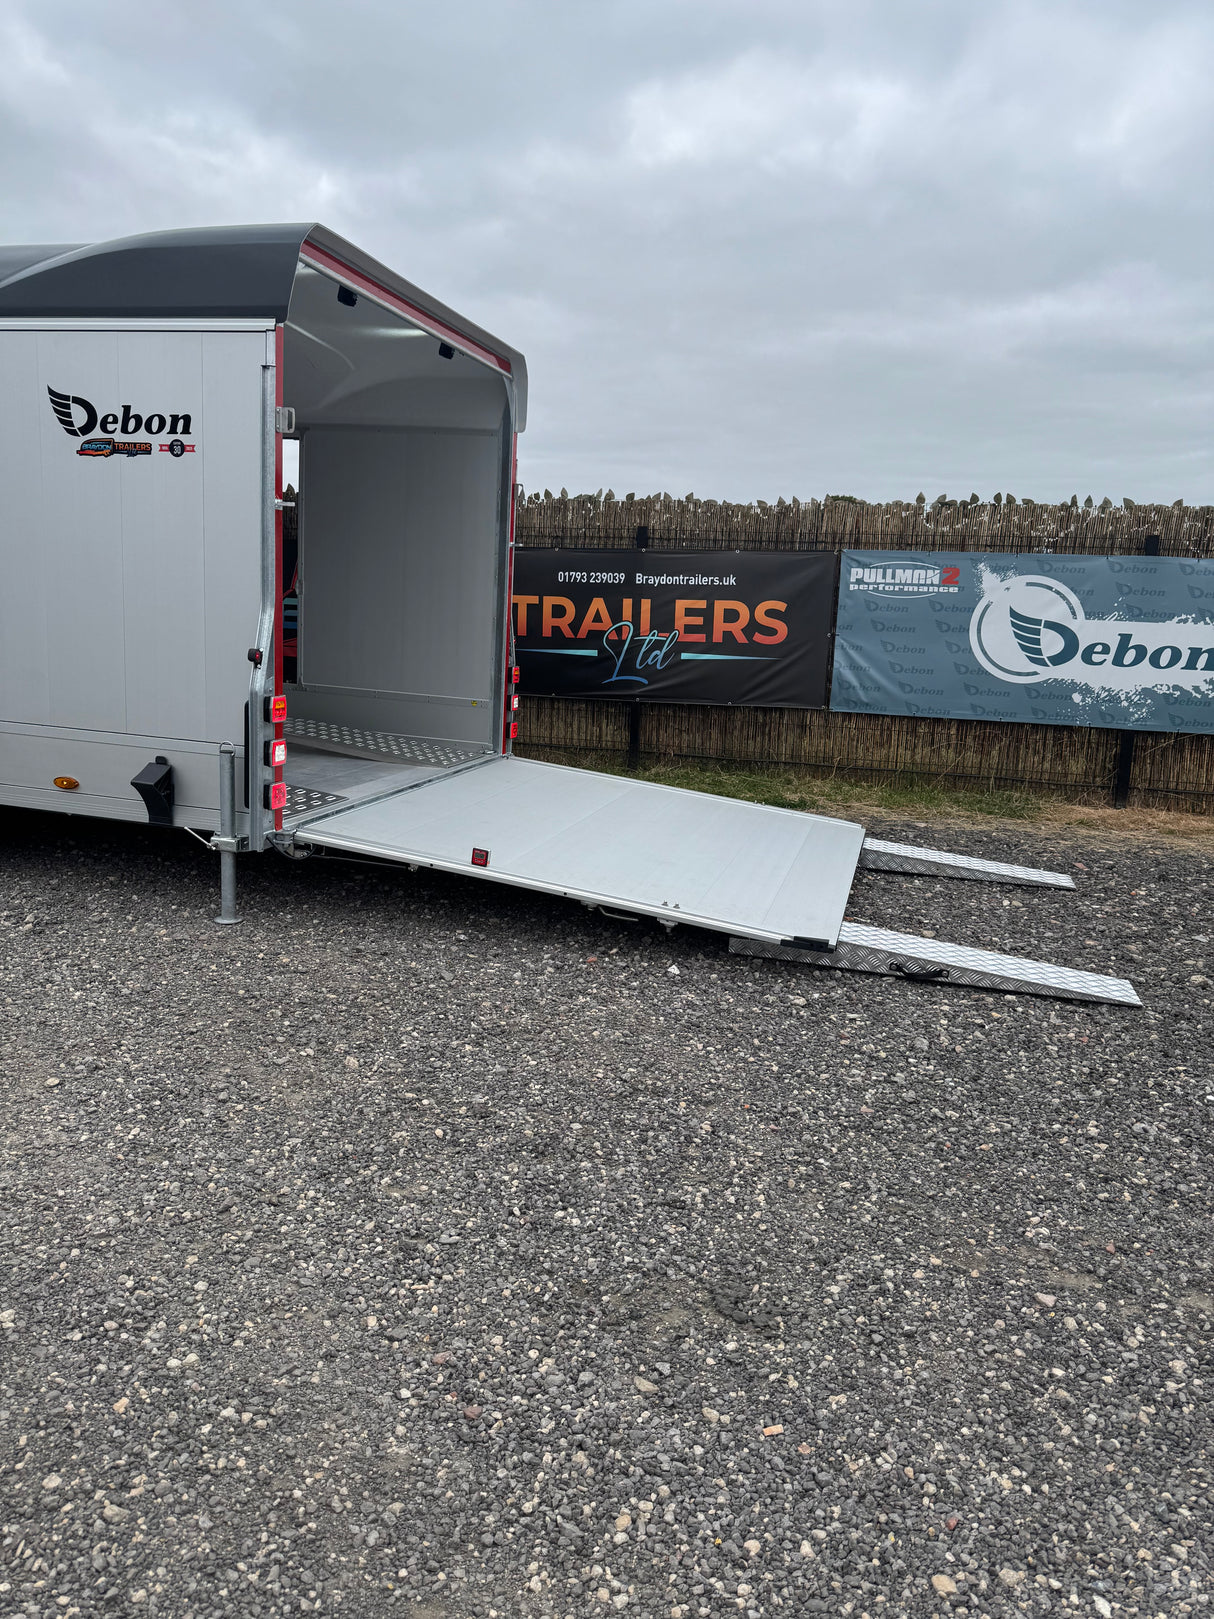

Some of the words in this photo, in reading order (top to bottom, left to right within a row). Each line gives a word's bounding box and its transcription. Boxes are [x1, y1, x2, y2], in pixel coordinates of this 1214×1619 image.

[47, 384, 192, 437] Debon
[114, 443, 151, 451] TRAILERS
[1107, 560, 1159, 574] Debon
[557, 571, 587, 583] 01793
[589, 572, 625, 584] 239039
[635, 573, 736, 586] Braydontrailers.uk
[850, 568, 940, 584] PULLMAN
[941, 567, 960, 585] 2
[849, 584, 959, 593] performance
[1115, 582, 1166, 598] Debon
[864, 599, 909, 613] Debon
[512, 595, 789, 645] TRAILERS
[870, 619, 916, 633] Debon
[602, 620, 680, 685] Ltd
[880, 640, 926, 654] Debon
[888, 660, 934, 674] Debon
[898, 681, 944, 696] Debon
[964, 683, 1010, 697] Debon
